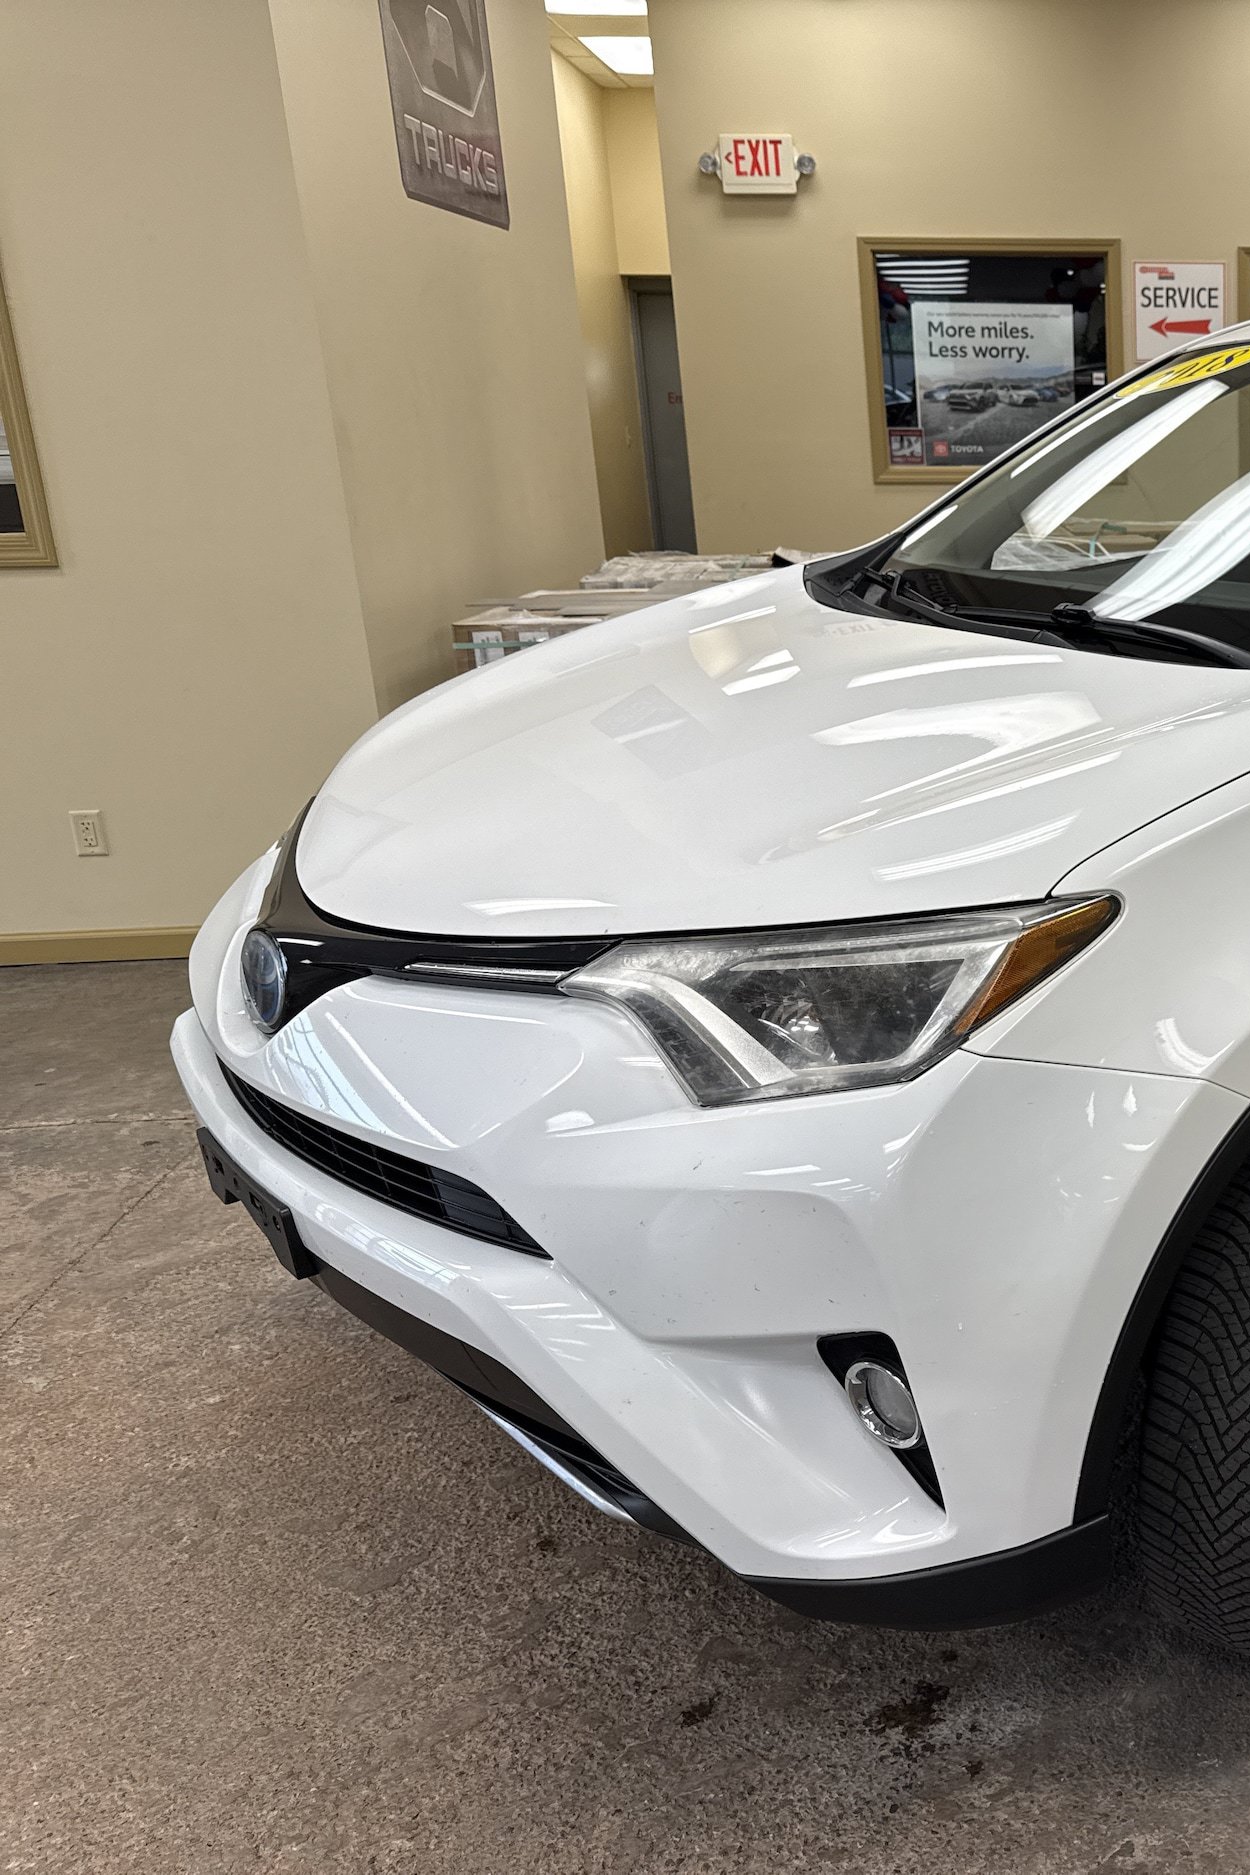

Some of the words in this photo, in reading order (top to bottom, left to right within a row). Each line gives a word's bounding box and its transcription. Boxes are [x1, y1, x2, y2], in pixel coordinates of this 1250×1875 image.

[404, 113, 499, 196] TRUCKS
[733, 139, 782, 176] EXIT
[1141, 287, 1219, 308] SERVICE
[928, 321, 976, 338] More
[981, 321, 1034, 339] miles.
[929, 341, 968, 358] Less
[972, 345, 1029, 363] worry.
[950, 445, 984, 453] TOYOTA
